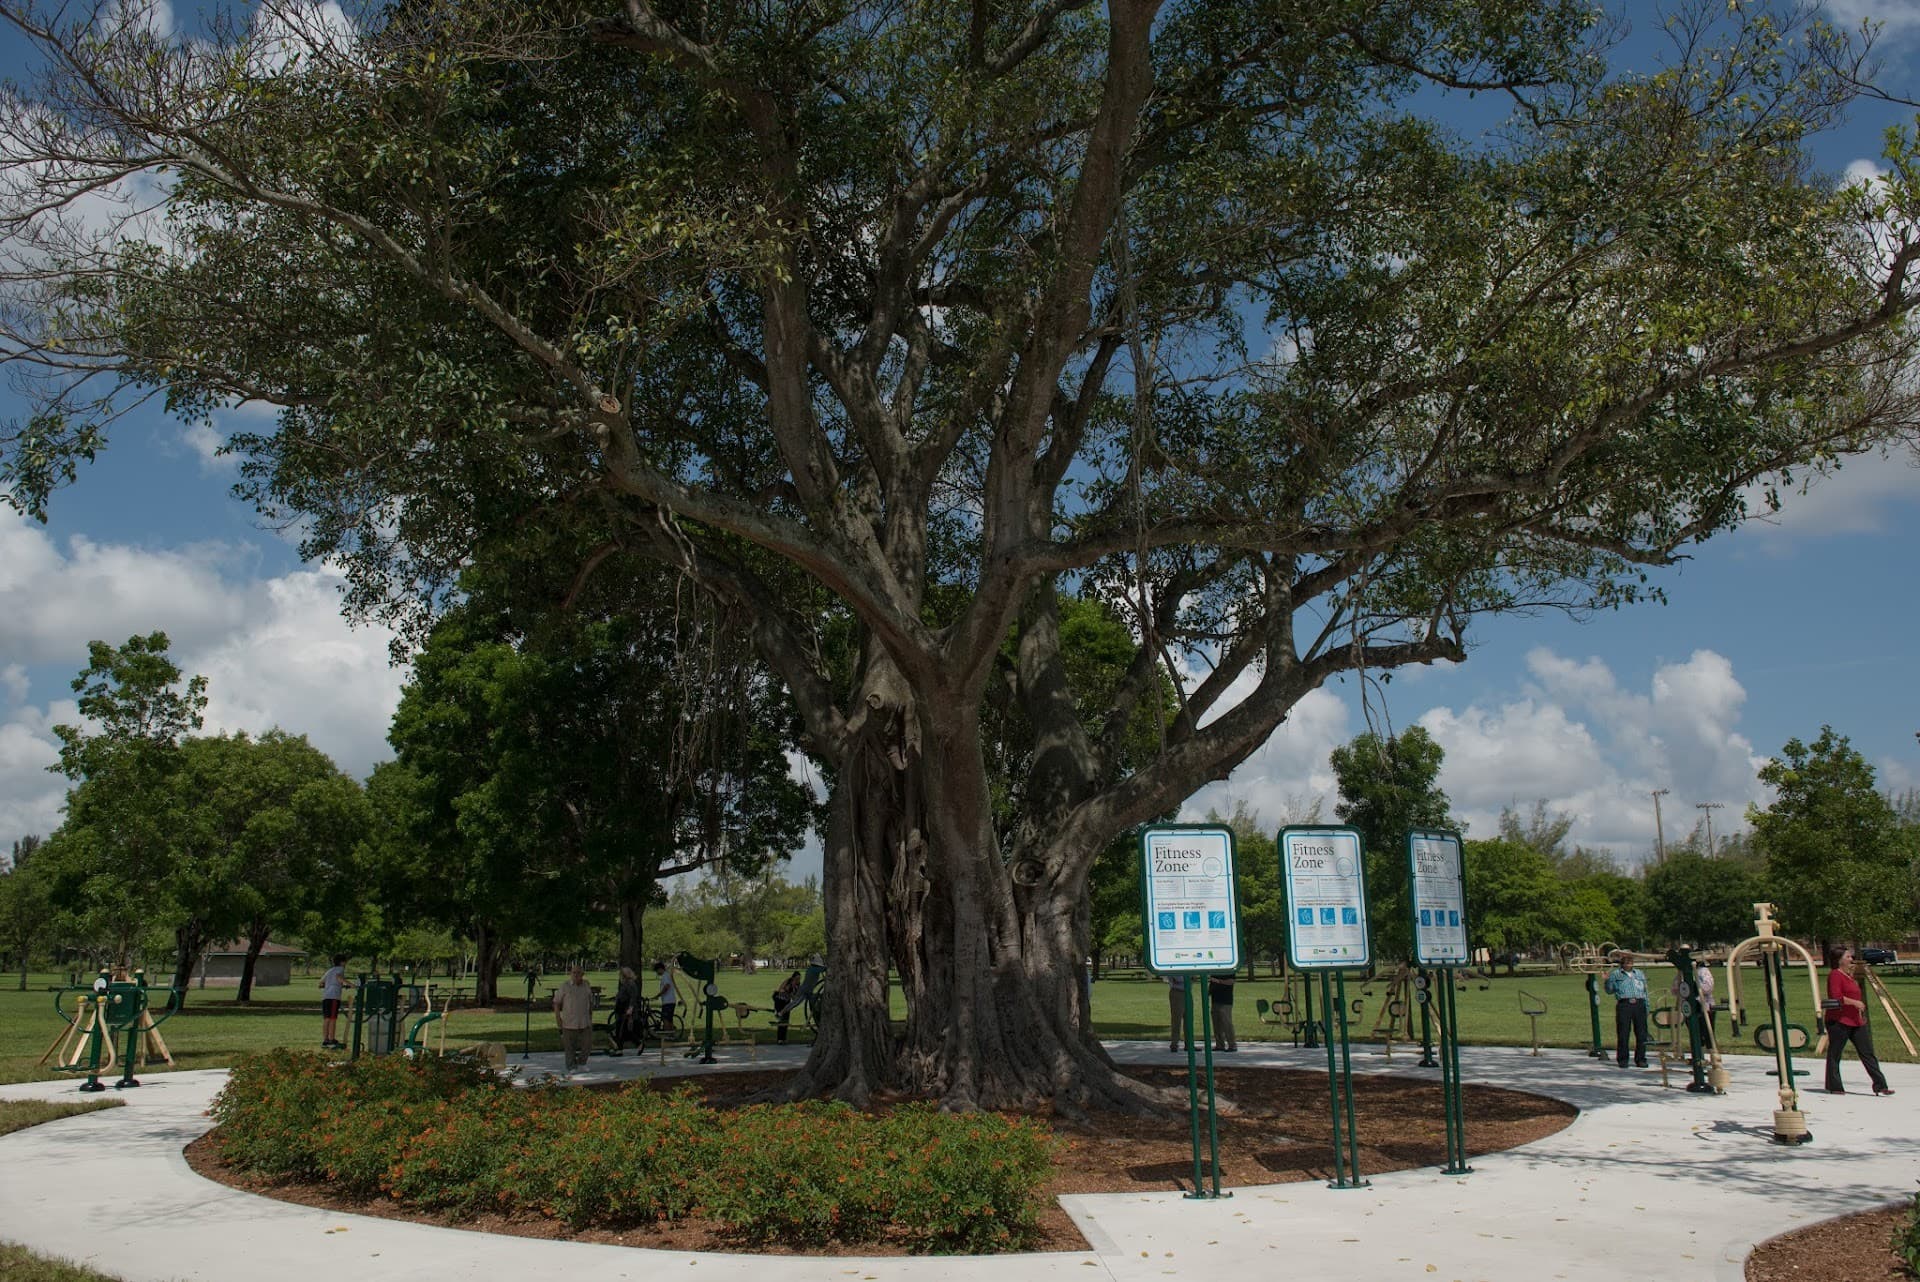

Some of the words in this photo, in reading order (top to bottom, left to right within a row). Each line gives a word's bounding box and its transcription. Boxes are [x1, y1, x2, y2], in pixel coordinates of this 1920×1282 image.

[1155, 846, 1202, 859] Fitness
[1292, 843, 1335, 856] Fitness
[1416, 849, 1445, 862] Fitness
[1155, 860, 1189, 873] Zone
[1294, 856, 1324, 869] Zone
[1417, 861, 1438, 874] Zone
